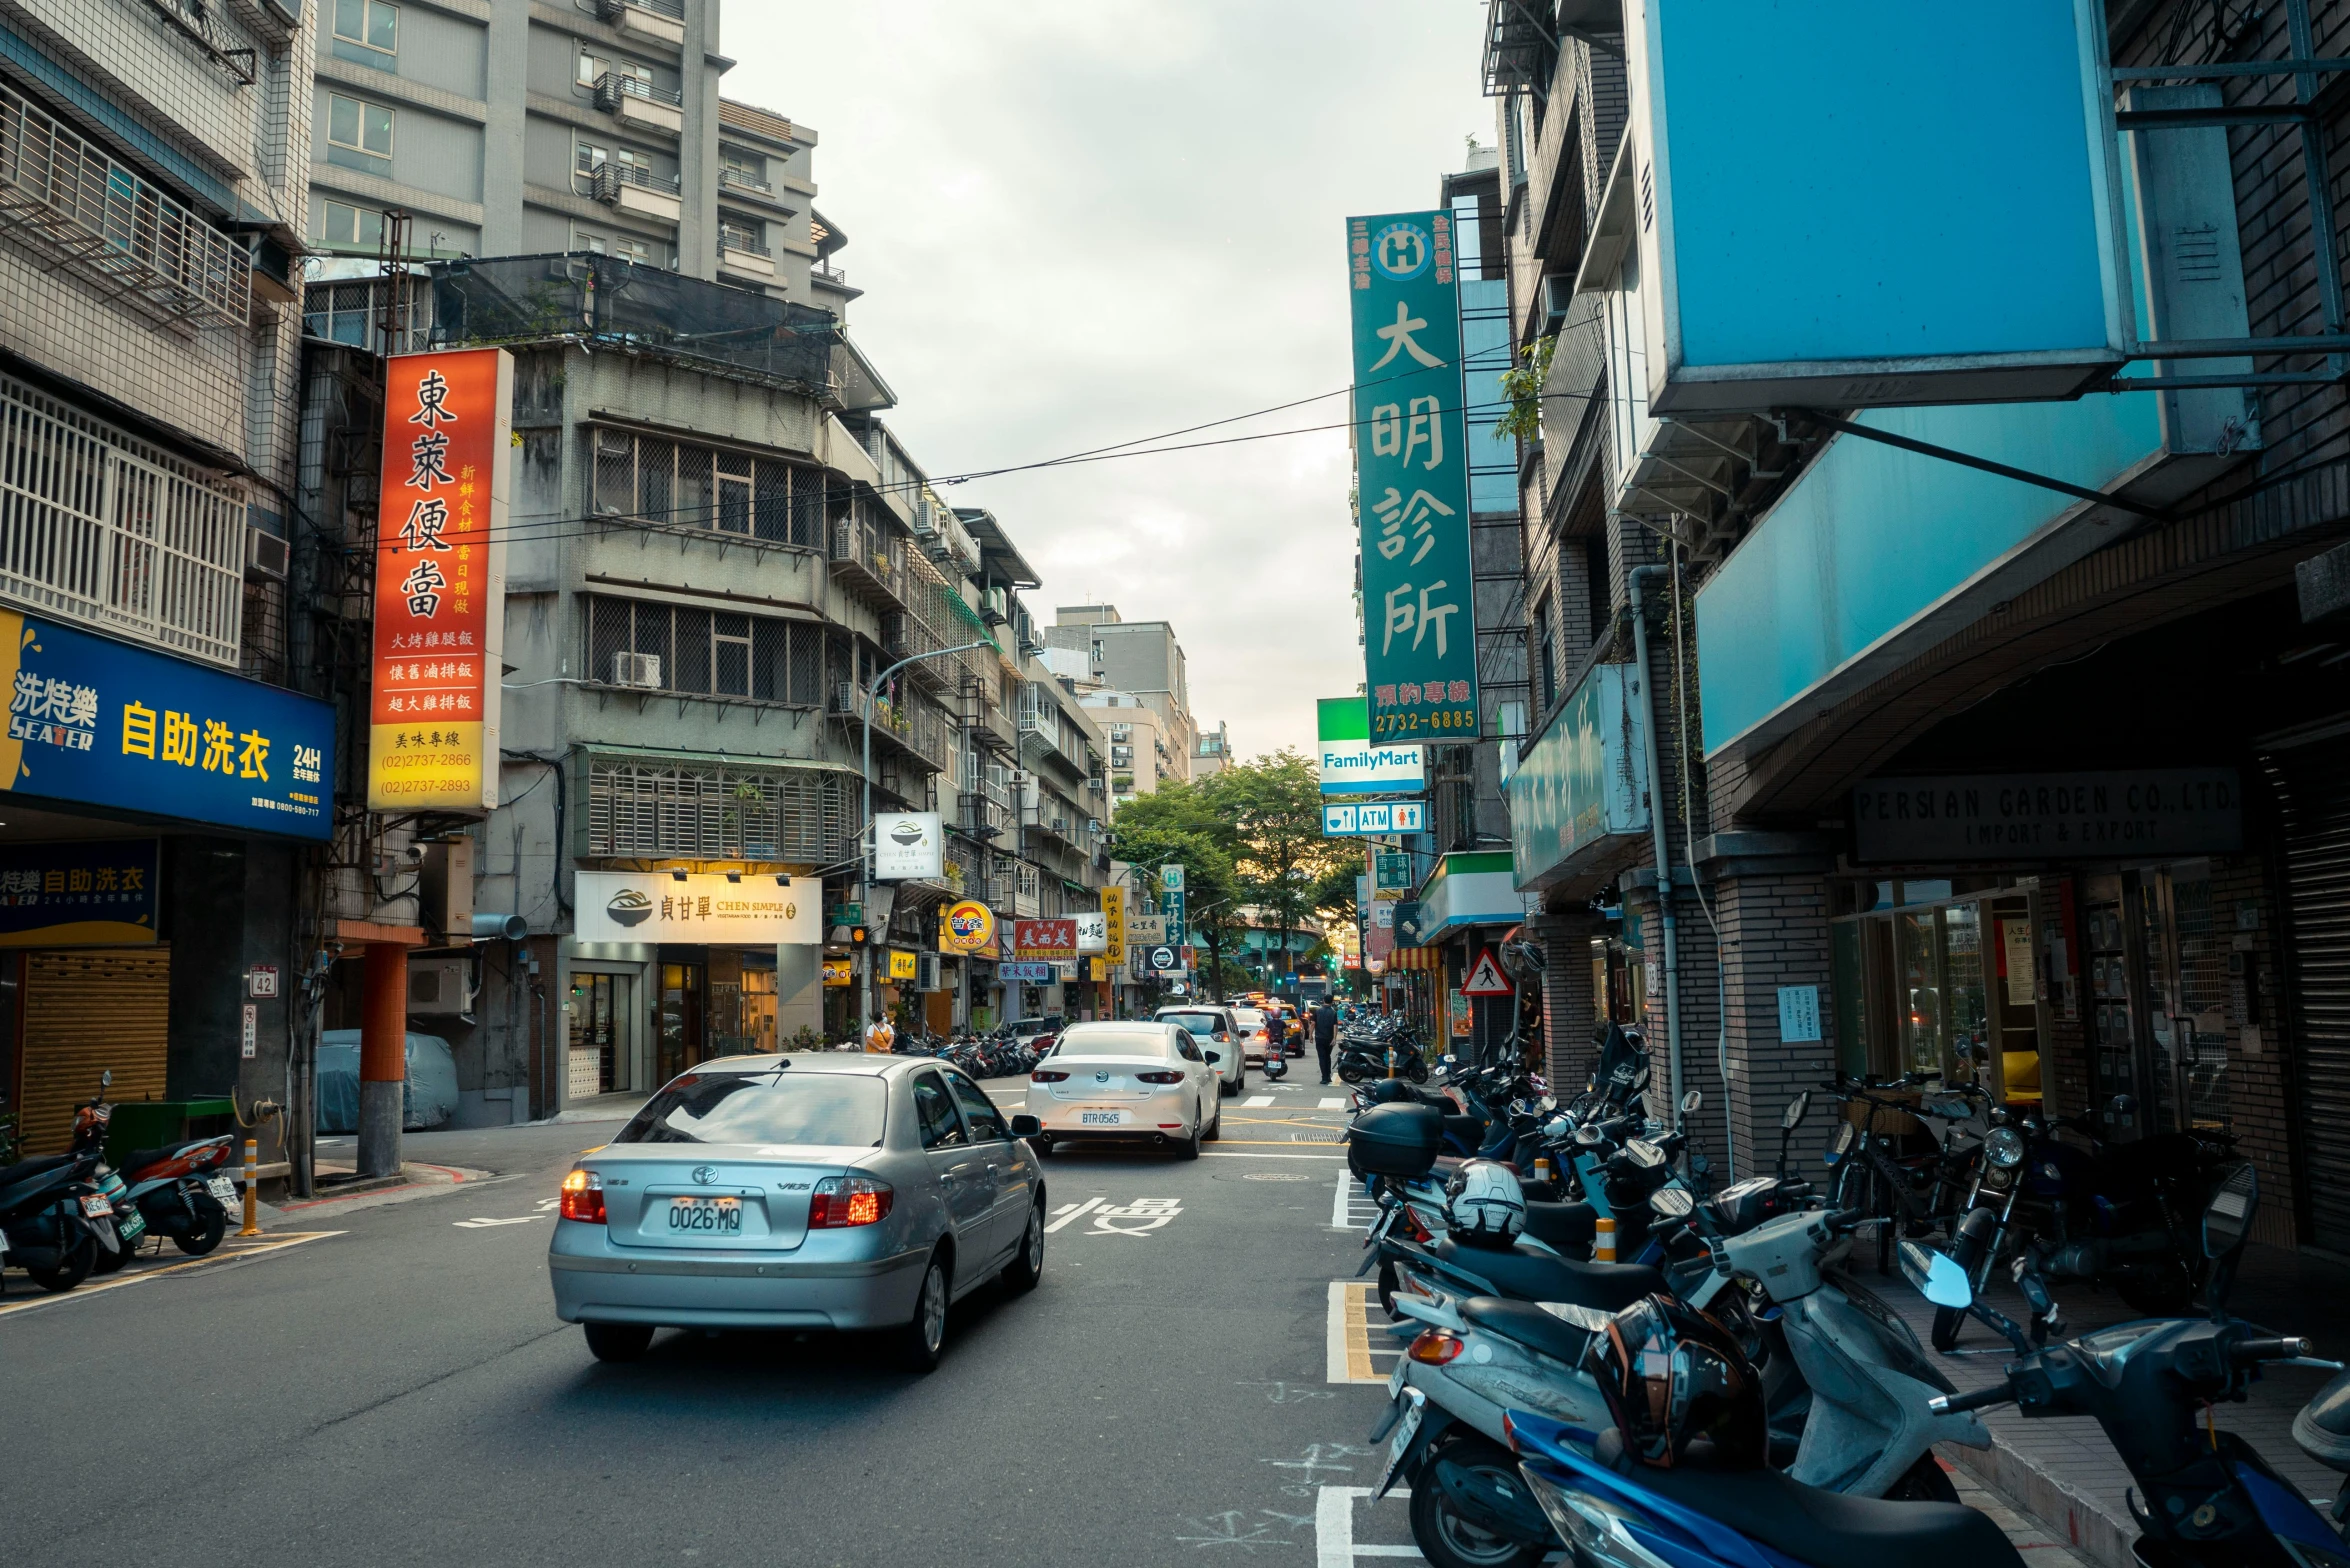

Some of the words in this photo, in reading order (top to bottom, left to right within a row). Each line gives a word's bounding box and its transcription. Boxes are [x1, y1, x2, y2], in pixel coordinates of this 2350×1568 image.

[1352, 221, 1371, 290] 三總主治
[1432, 214, 1453, 285] 全民健保
[1368, 300, 1459, 660] 大明診所
[399, 369, 458, 619] 東萊便當
[457, 464, 476, 533] 新鮮食材
[453, 544, 471, 614] 當日現做
[391, 630, 474, 650] 火烤雞腿飯
[389, 662, 473, 681] 懷舊滷排飯
[11, 671, 98, 728] 洗特樂
[387, 693, 473, 713] 超大雞排飯
[1374, 680, 1471, 708] 預約專線
[1376, 710, 1474, 733] 2732-6885
[122, 700, 270, 783] 自助洗衣
[395, 731, 461, 749] 美味專線
[293, 744, 321, 770] 24H
[382, 753, 471, 770] (02)2737-2866
[1323, 749, 1419, 771] FamilyMart
[292, 766, 320, 783] 全年無休
[381, 779, 470, 796] (02)2737-2893
[1859, 788, 1979, 820] PERSIAN
[1999, 784, 2109, 818] GARDEN
[1361, 809, 1388, 827] ATM
[1966, 823, 2042, 845] IMPORT
[2058, 823, 2071, 842] &
[2082, 820, 2158, 842] EXPORT
[44, 866, 145, 894] 自助洗衣
[660, 894, 712, 922] 貞甘單
[716, 901, 750, 911] CHEN
[752, 902, 784, 912] SIMPLE
[1021, 928, 1070, 947] 美而美
[2008, 926, 2025, 936] 人生
[1001, 965, 1046, 978] 紫米飯糰
[257, 977, 271, 993] 42
[777, 1182, 811, 1190] VIOS
[1044, 1197, 1185, 1237] 慢
